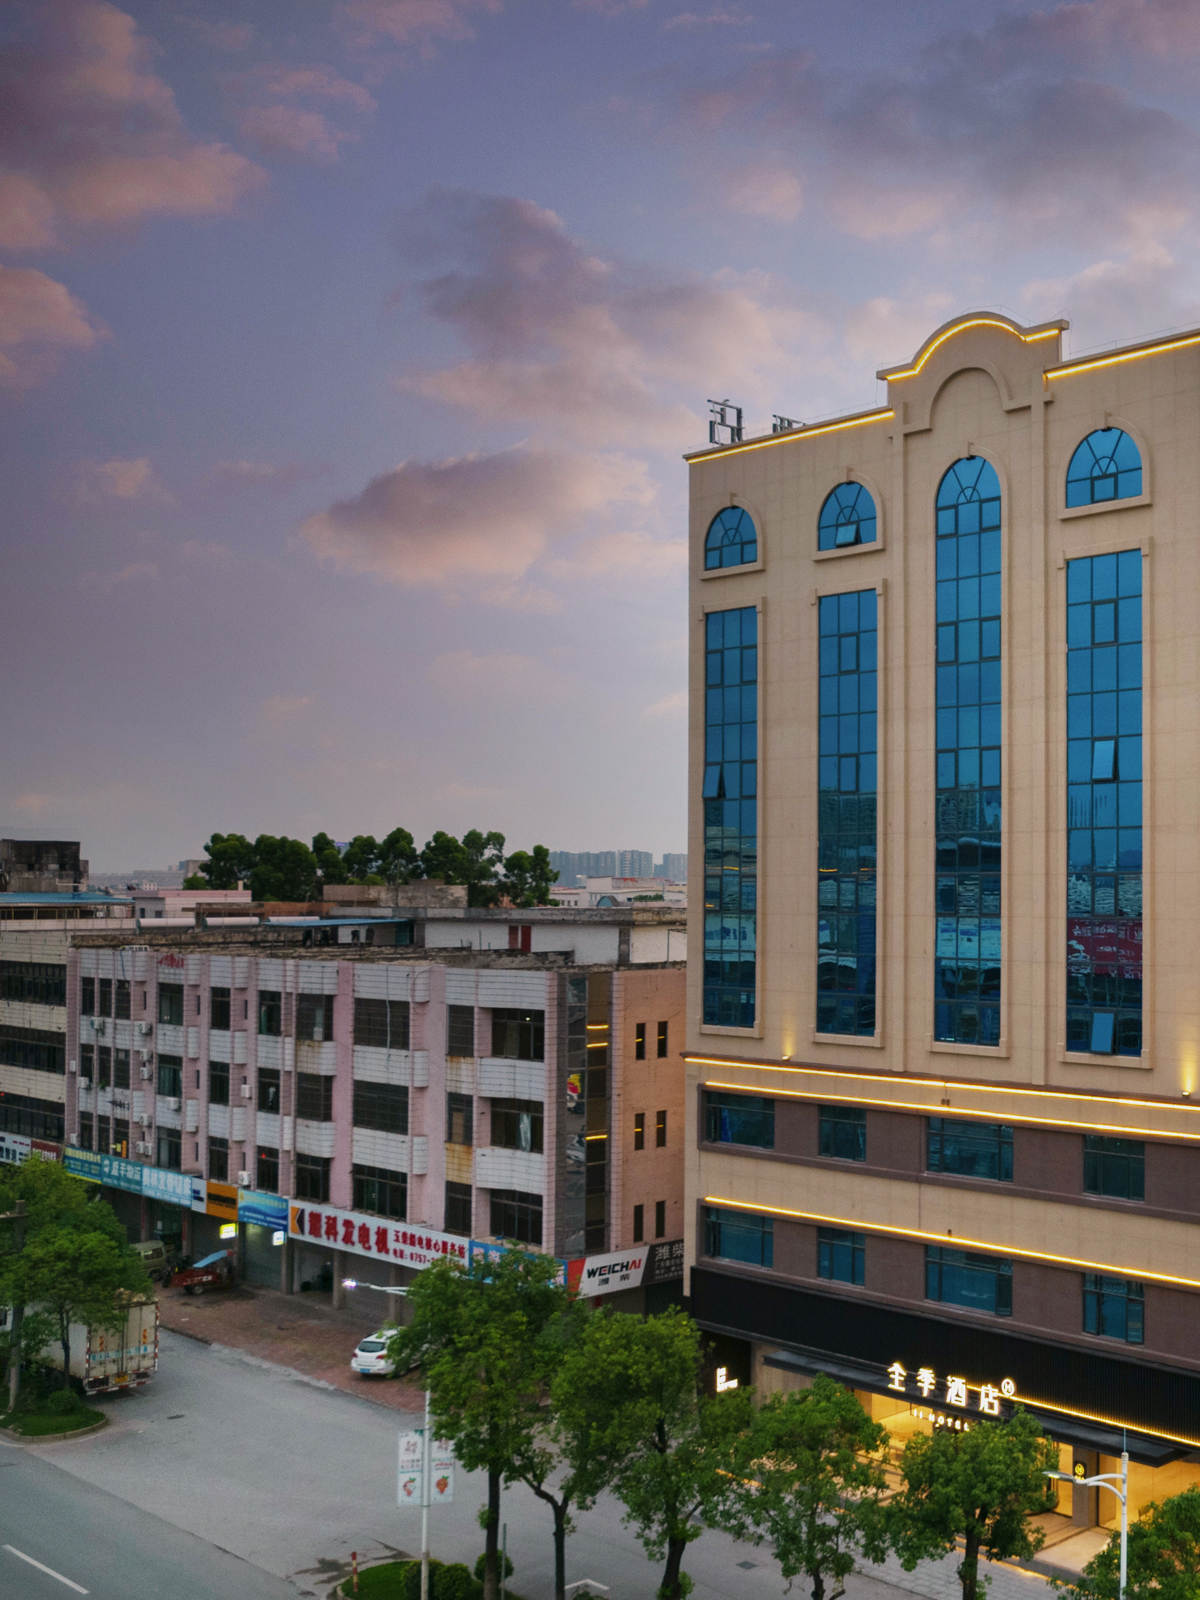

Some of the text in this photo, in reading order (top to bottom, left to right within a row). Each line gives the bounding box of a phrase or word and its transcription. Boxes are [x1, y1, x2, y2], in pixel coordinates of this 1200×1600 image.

[587, 1259, 642, 1279] WEICHAI
[887, 1362, 999, 1415] 全季酒店
[928, 1412, 970, 1432] HOTEL
